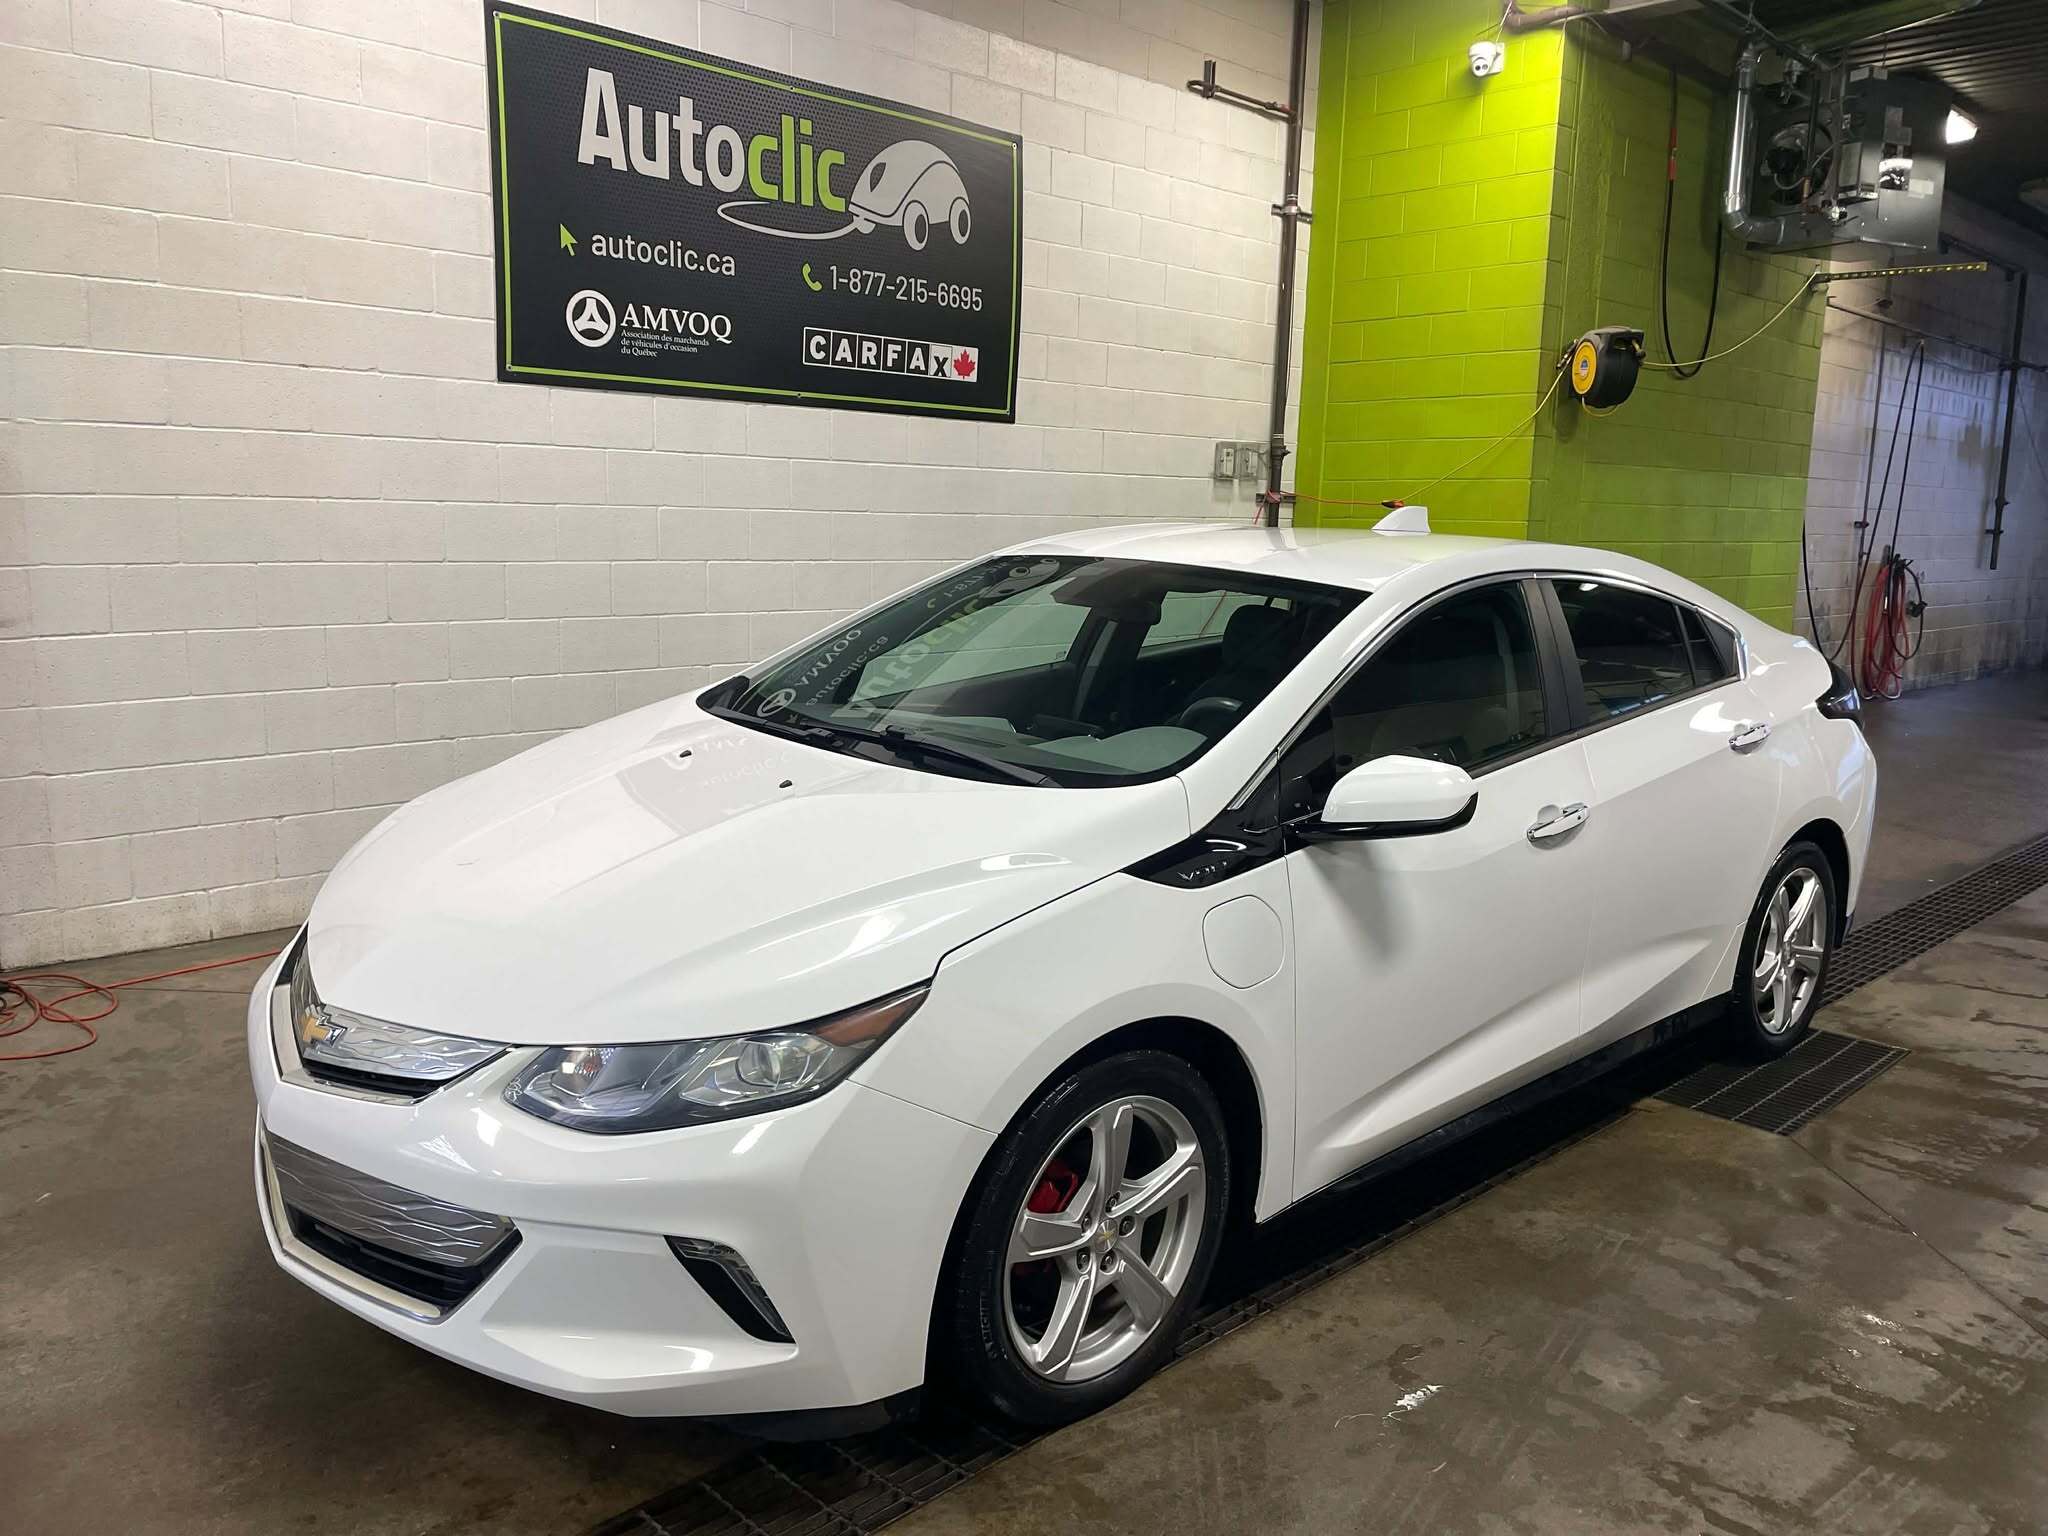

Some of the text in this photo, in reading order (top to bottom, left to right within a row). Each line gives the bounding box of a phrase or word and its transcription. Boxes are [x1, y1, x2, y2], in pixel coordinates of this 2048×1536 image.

[577, 67, 846, 213] Autoclic
[591, 232, 736, 277] autoclic.ca
[829, 265, 983, 312] 1-877-215-6695
[620, 303, 733, 345] AMVOQ
[620, 338, 630, 346] de
[631, 338, 663, 350] véhicules
[621, 329, 709, 346] Association des marchands
[620, 346, 658, 358] du Québec
[809, 335, 949, 378] CARFAX
